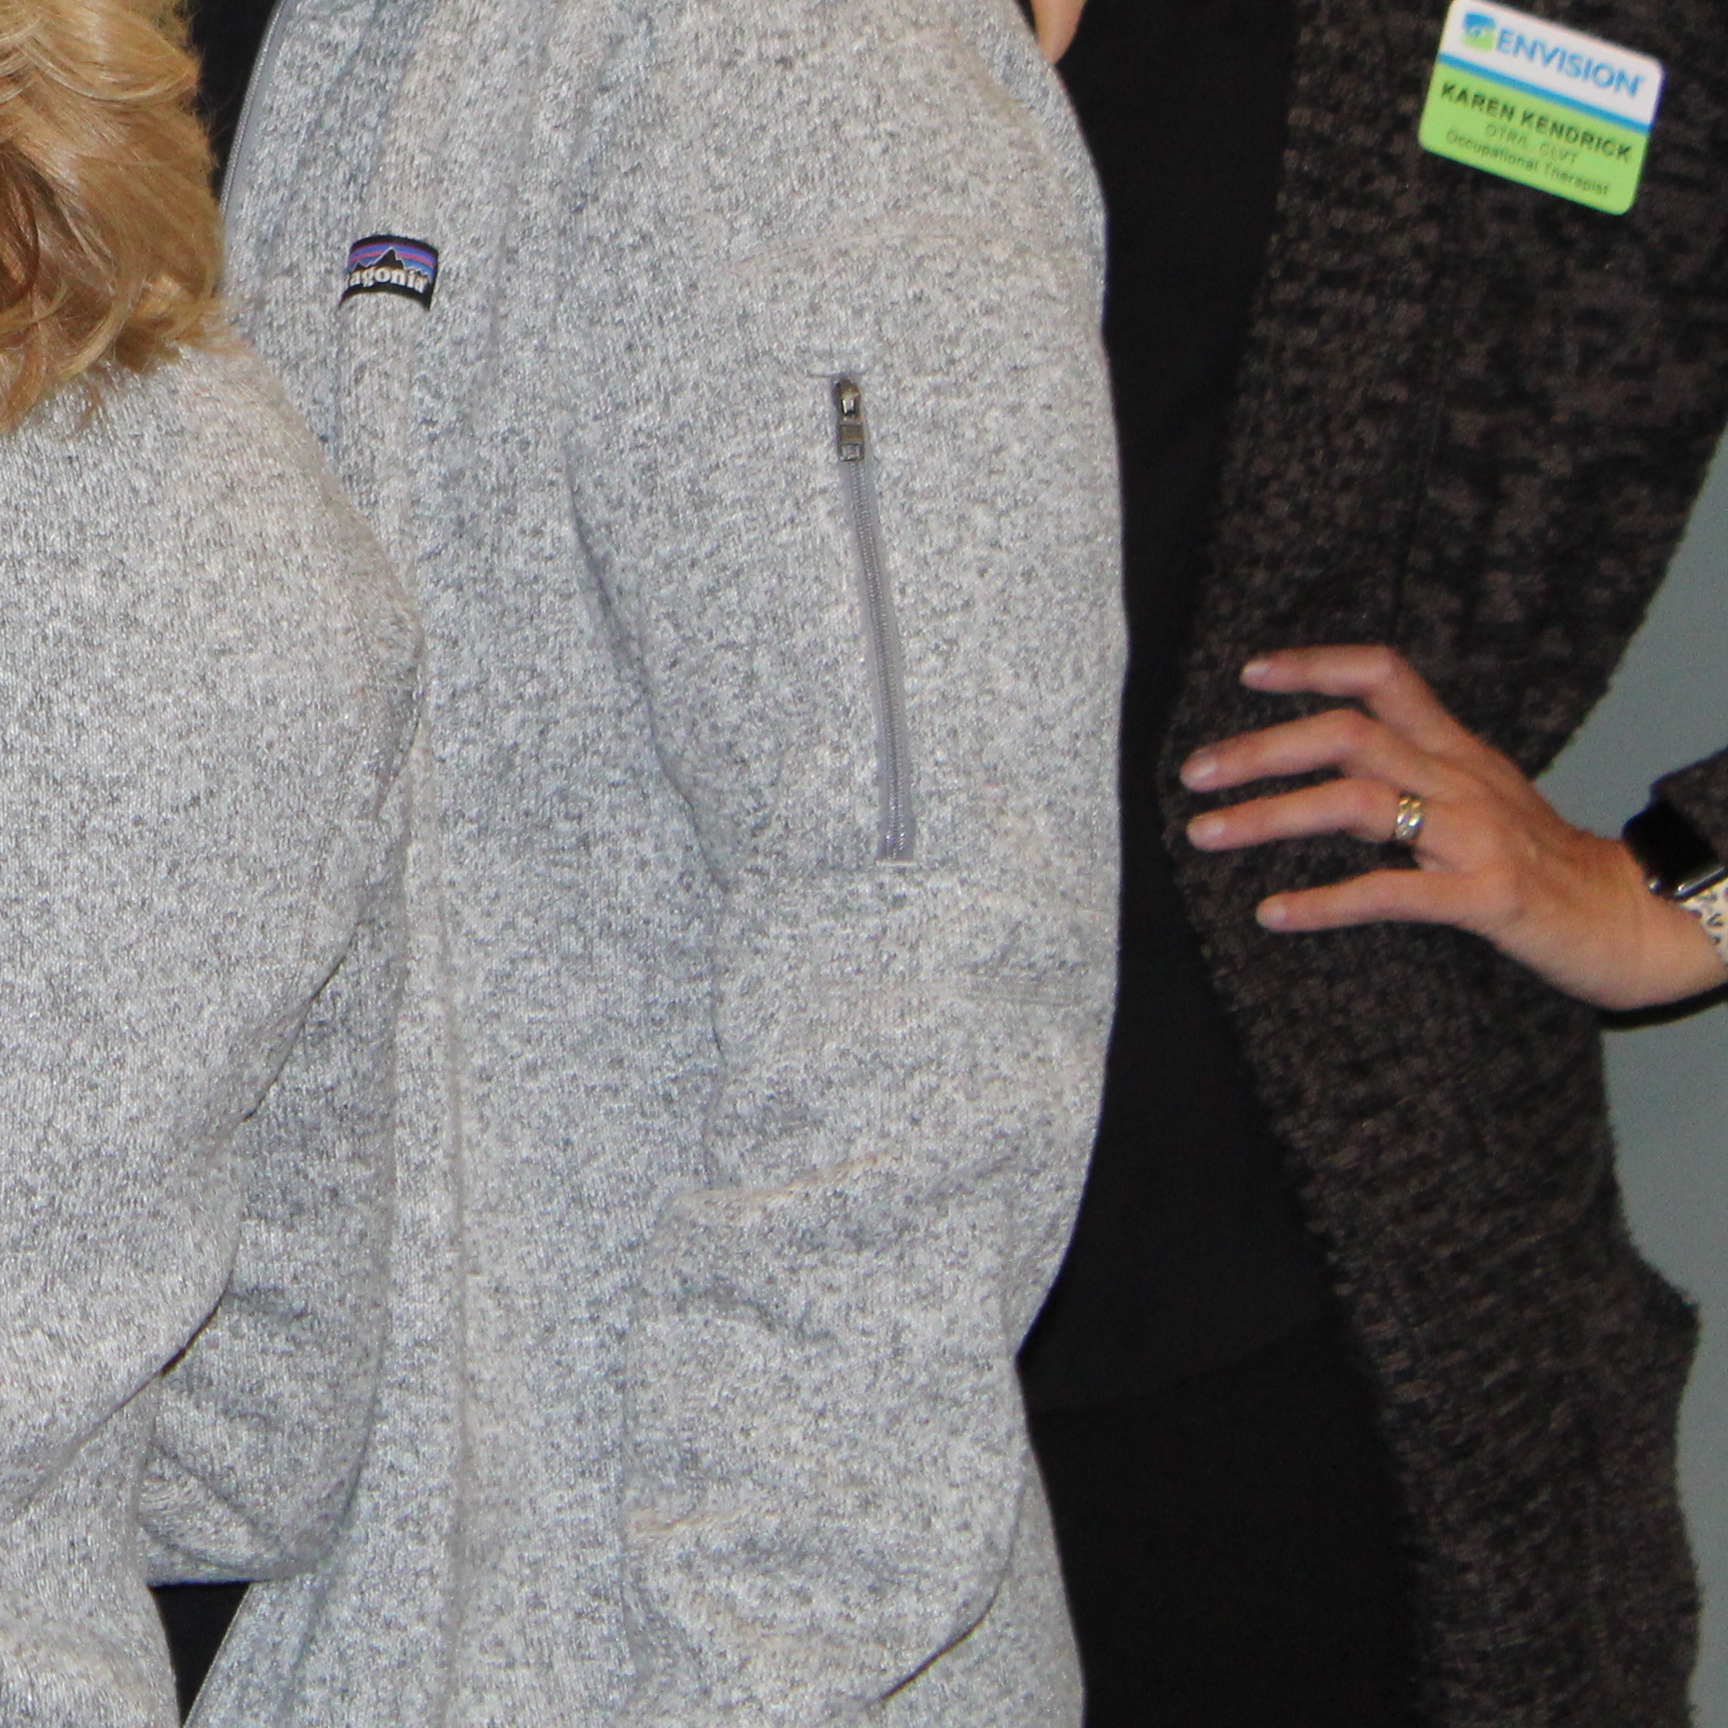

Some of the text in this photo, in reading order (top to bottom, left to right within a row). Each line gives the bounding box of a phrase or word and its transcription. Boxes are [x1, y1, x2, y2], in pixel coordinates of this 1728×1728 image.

[1496, 28, 1642, 98] ENVISION
[1441, 82, 1634, 163] KAREN KENDRICK
